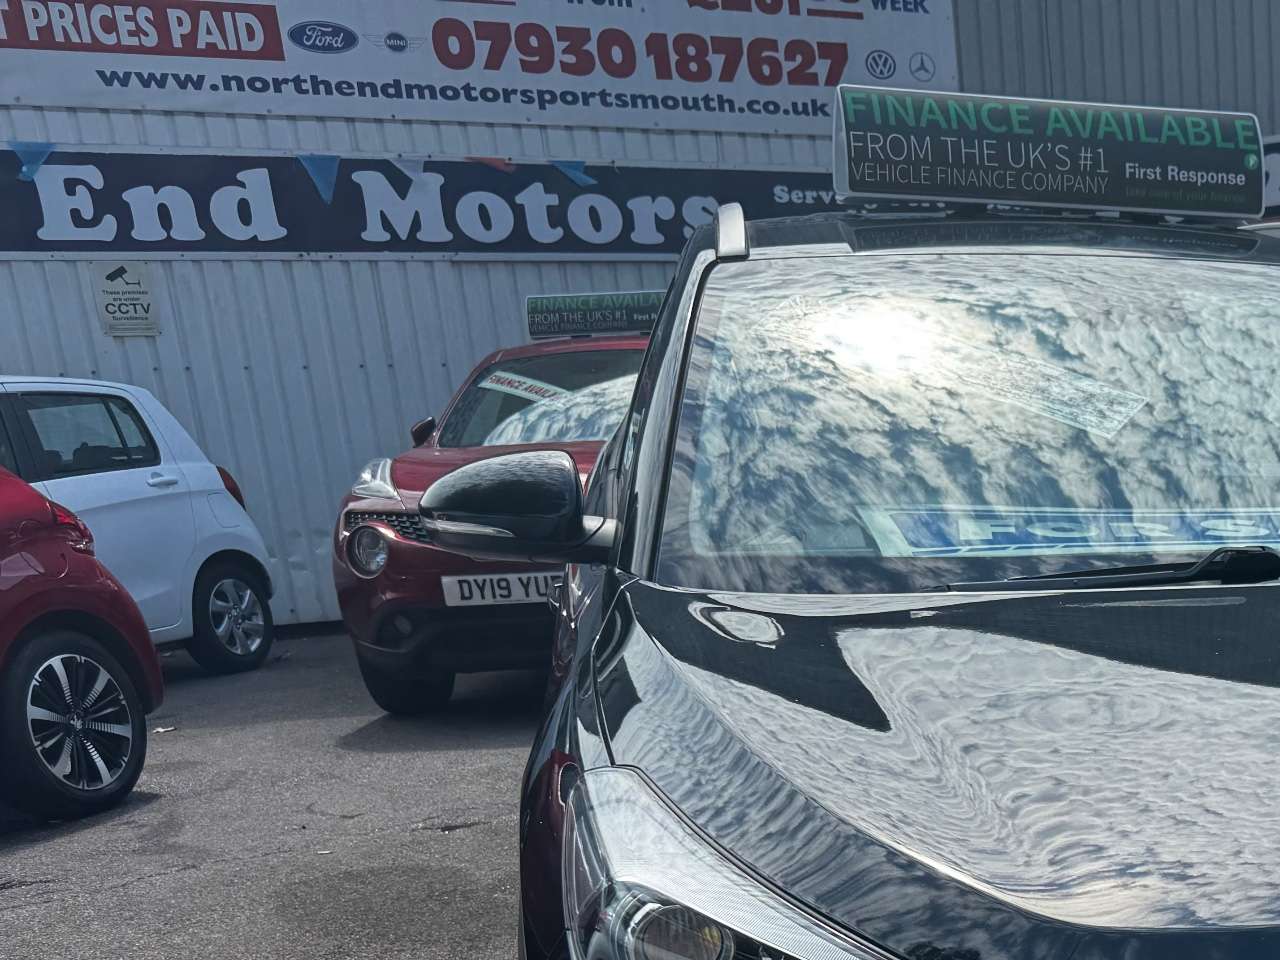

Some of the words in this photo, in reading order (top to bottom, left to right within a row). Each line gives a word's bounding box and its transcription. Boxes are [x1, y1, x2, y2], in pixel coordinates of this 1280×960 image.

[23, 0, 159, 46] PRICES
[167, 8, 265, 52] PAID
[304, 25, 344, 47] Ford
[386, 38, 406, 46] MINI
[432, 18, 636, 79] 07930
[645, 33, 849, 87] 187627
[96, 69, 831, 118] www.northendmotorsportsmouth.co.uk
[845, 91, 1035, 135] FINANCE
[1046, 104, 1259, 151] AVAILABLE
[849, 131, 933, 163] FROM
[940, 137, 999, 167] THE
[1007, 141, 1071, 171] UK'S
[1080, 148, 1109, 174] #1
[850, 161, 932, 185] VEHICLE
[937, 167, 1017, 190] FINANCE
[1021, 171, 1109, 195] COMPANY
[1125, 163, 1162, 180] First
[1167, 165, 1246, 186] Response
[33, 164, 288, 242] End
[352, 170, 717, 245] Motors
[105, 303, 150, 314] CCTV
[528, 295, 598, 311] FINANCE
[603, 293, 664, 308] AVAILA
[529, 312, 559, 325] FROM
[561, 311, 583, 322] THE
[958, 519, 1170, 540] FOR
[457, 577, 511, 600] DY19
